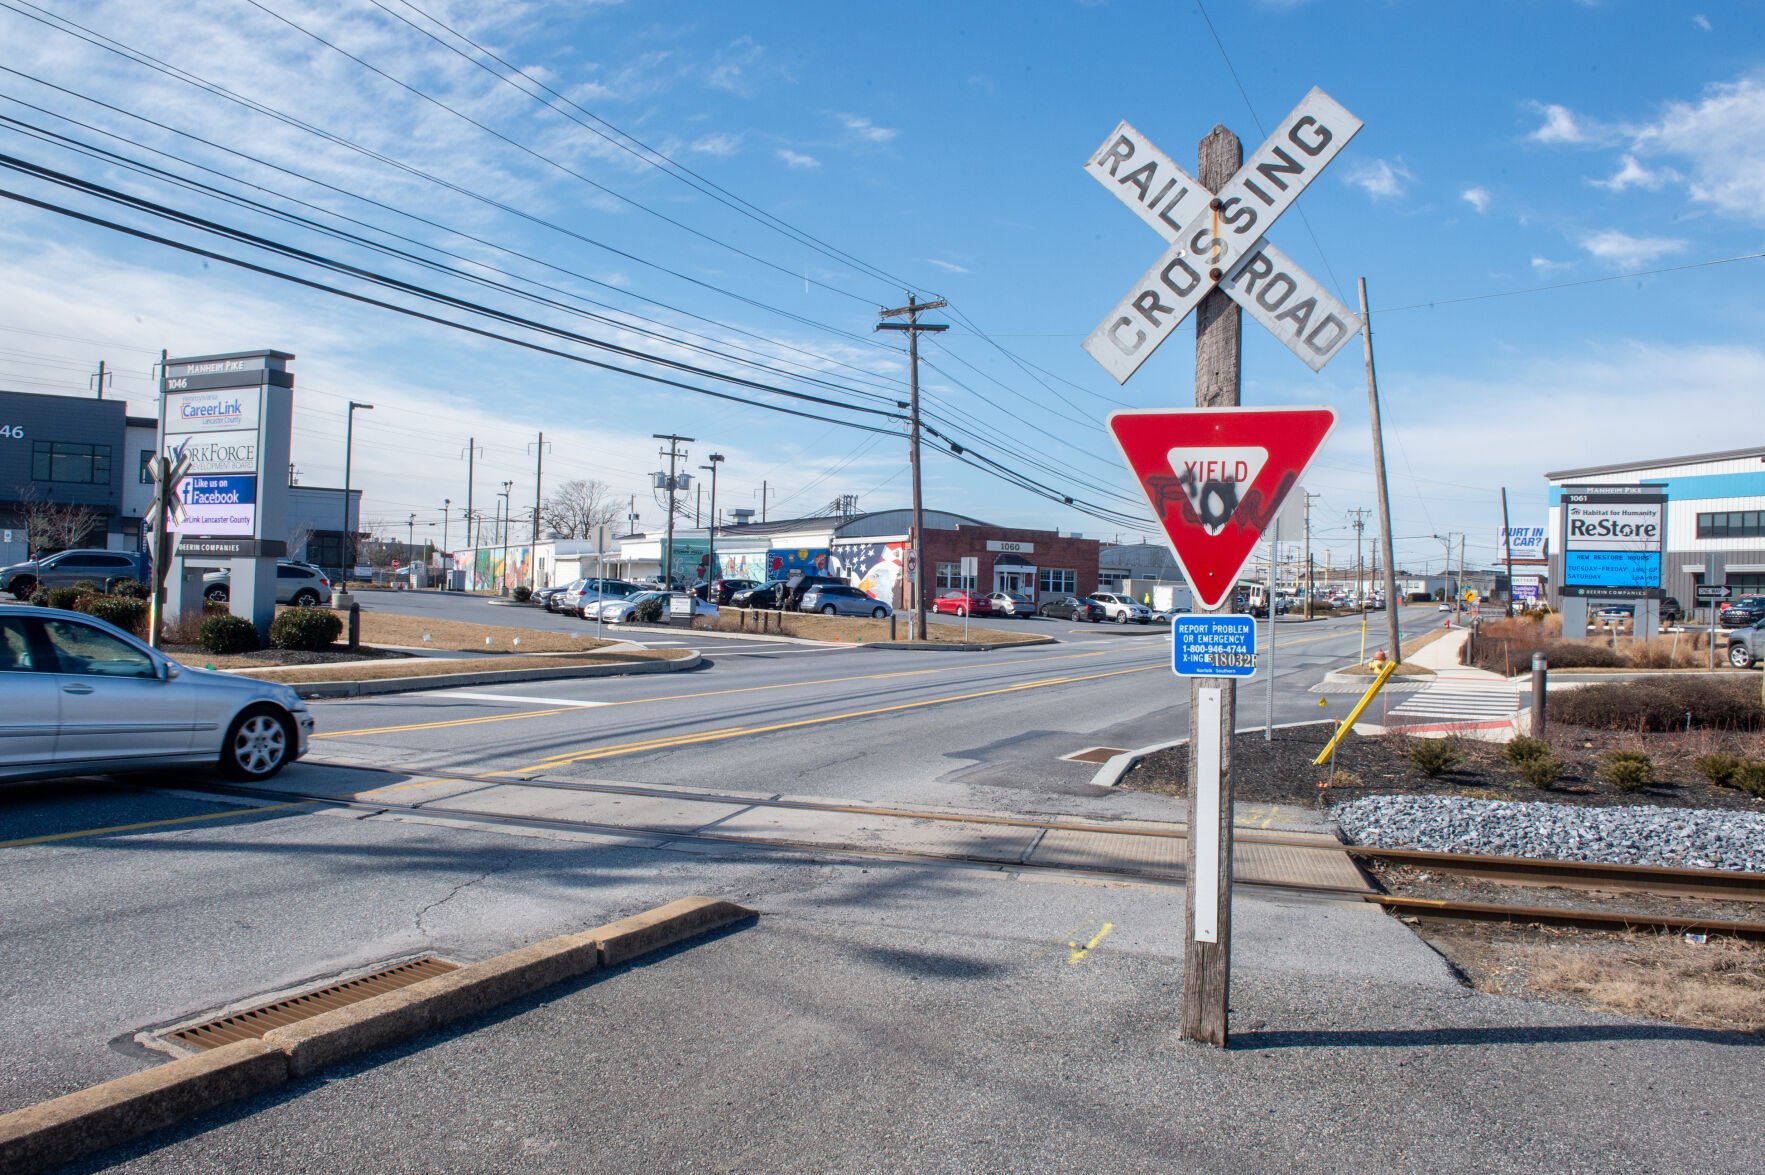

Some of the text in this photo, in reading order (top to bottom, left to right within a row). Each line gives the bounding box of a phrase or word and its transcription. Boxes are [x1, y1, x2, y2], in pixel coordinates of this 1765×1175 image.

[1107, 115, 1334, 357] CROSSING
[1098, 134, 1348, 357] RAIL ROAD
[188, 361, 244, 374] MANHEIM PIKE
[169, 378, 188, 388] 1046
[182, 398, 242, 417] CareerLink
[1184, 461, 1248, 482] YIELD
[194, 479, 208, 488] Like
[194, 490, 239, 504] Facebook
[230, 516, 250, 525] County
[1532, 528, 1544, 536] IN
[1571, 519, 1656, 537] ReStore
[1513, 538, 1542, 546] CAR?
[1179, 624, 1249, 634] REPORT PROBLEM
[1184, 634, 1245, 643] OR EMERGENCY
[1182, 645, 1247, 653] 1-800-946-4744
[1183, 654, 1203, 662] X-ING
